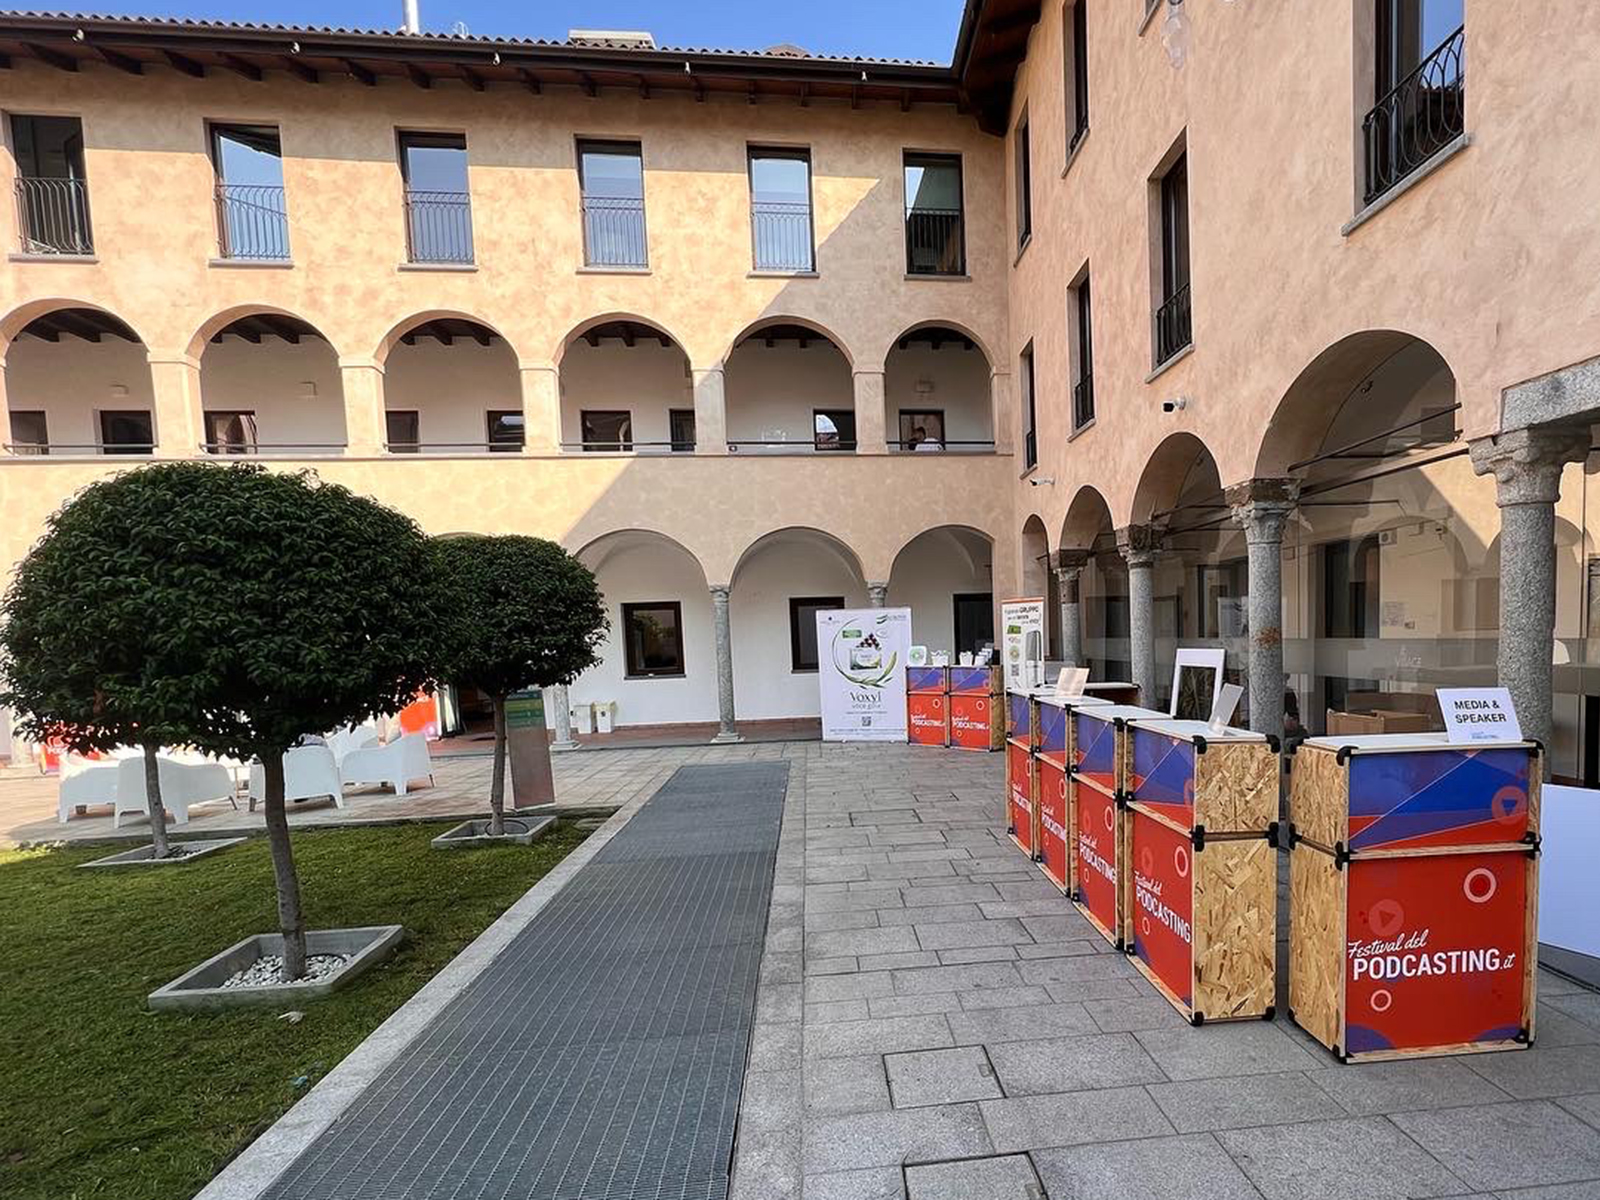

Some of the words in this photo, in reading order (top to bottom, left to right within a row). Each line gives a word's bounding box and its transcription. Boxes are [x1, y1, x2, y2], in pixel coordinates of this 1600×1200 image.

[1454, 700, 1490, 710] MEDIA
[1492, 700, 1500, 709] &
[1455, 713, 1507, 724] SPEAKER
[1348, 933, 1405, 959] Festival
[1404, 929, 1430, 950] del
